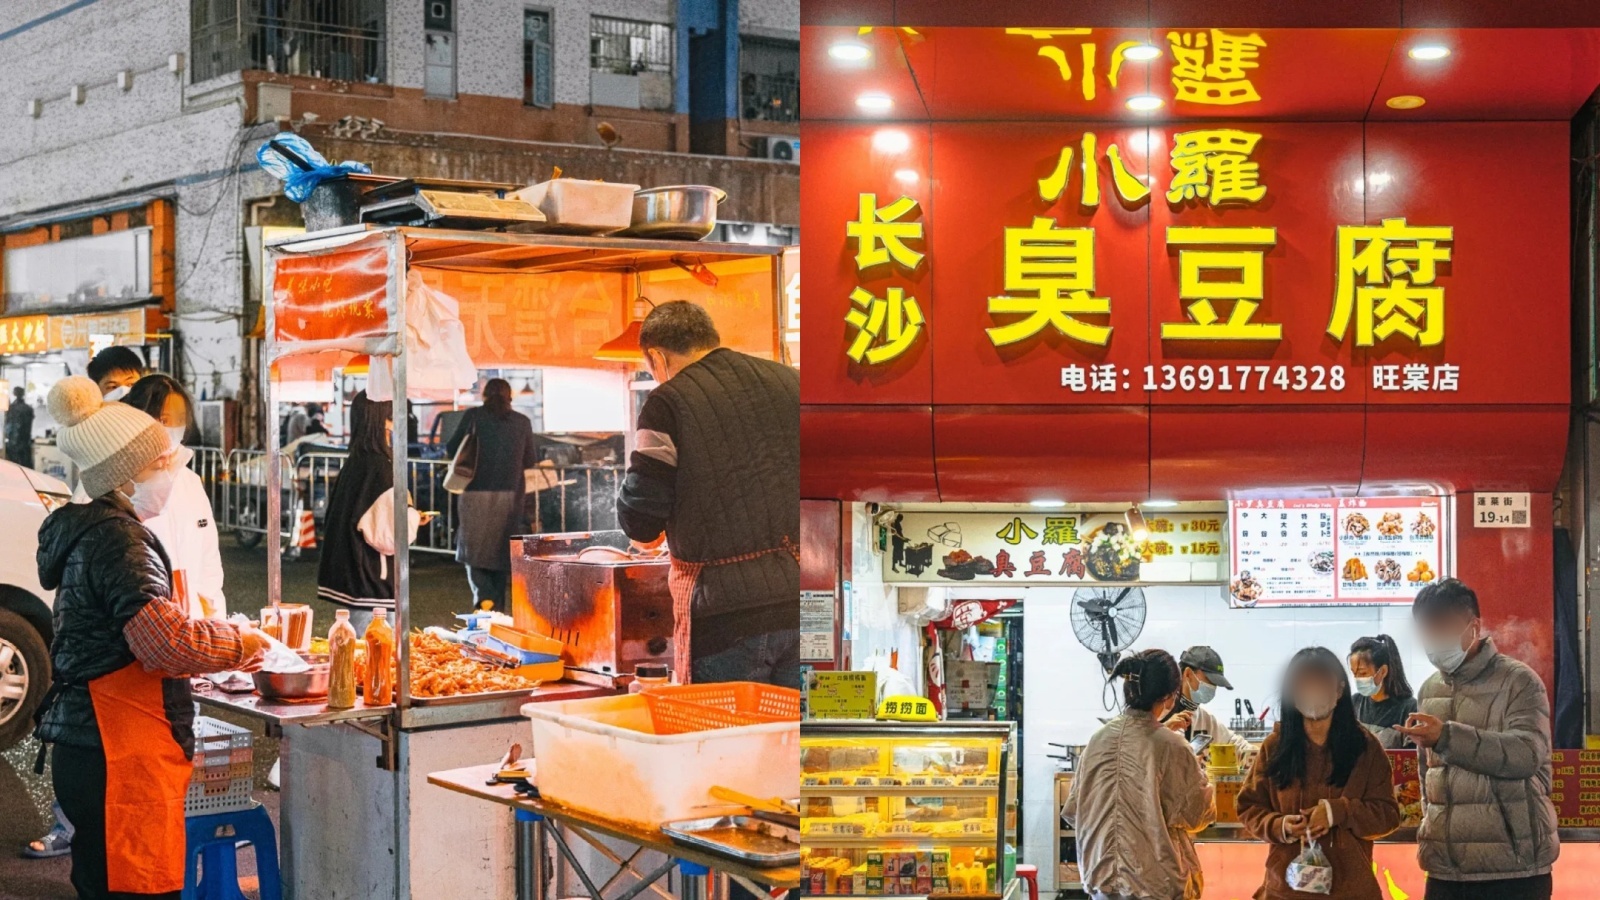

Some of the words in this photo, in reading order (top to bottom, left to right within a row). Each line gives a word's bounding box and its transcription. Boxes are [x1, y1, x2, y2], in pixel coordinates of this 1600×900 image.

[1038, 130, 1268, 206] 小羅
[847, 193, 926, 365] 长沙
[985, 217, 1454, 347] 臭豆腐
[1373, 364, 1460, 391] 旺棠店
[1477, 496, 1513, 506] 蓬莱街
[996, 517, 1082, 545] 小羅
[1480, 511, 1510, 523] 19-14
[989, 548, 1086, 580] 臭豆腐
[885, 701, 928, 716] 捞捞面
